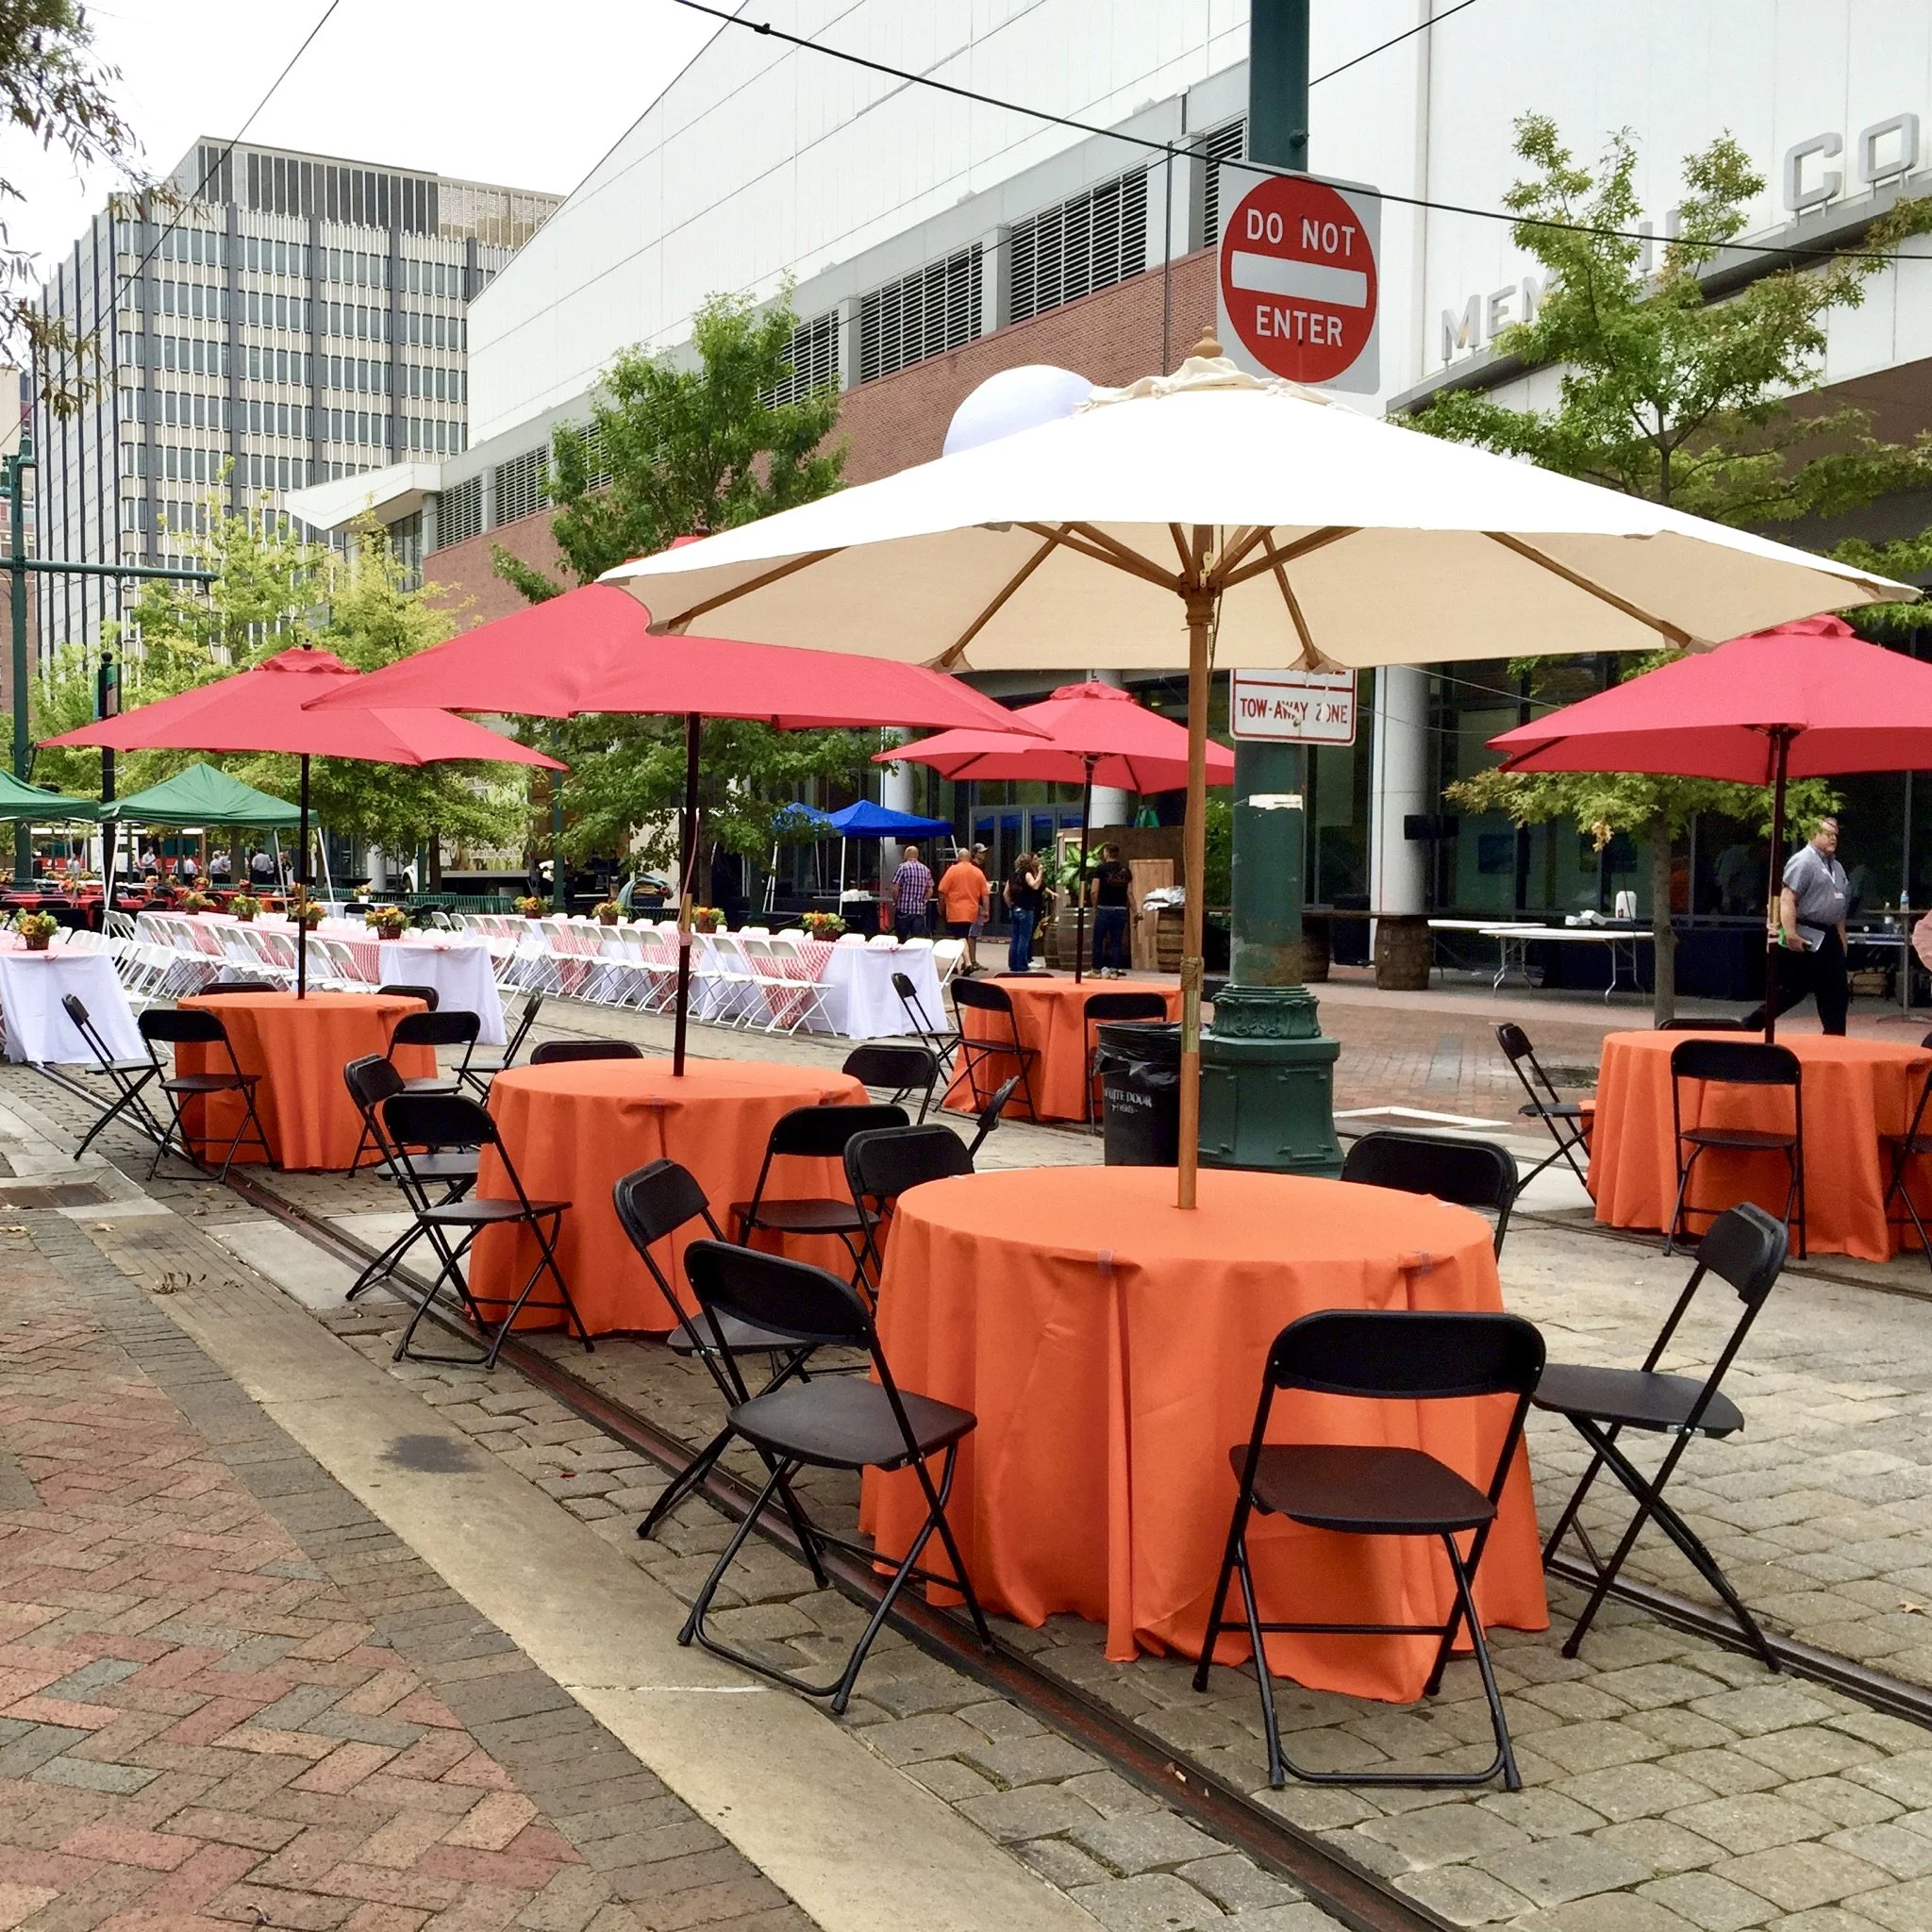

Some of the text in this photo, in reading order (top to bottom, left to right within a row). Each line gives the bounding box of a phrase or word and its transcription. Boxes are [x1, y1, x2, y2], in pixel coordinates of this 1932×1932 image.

[1246, 208, 1356, 257] DO NOT
[1256, 305, 1343, 347] ENTER
[1240, 698, 1308, 721] TOW-AWAY
